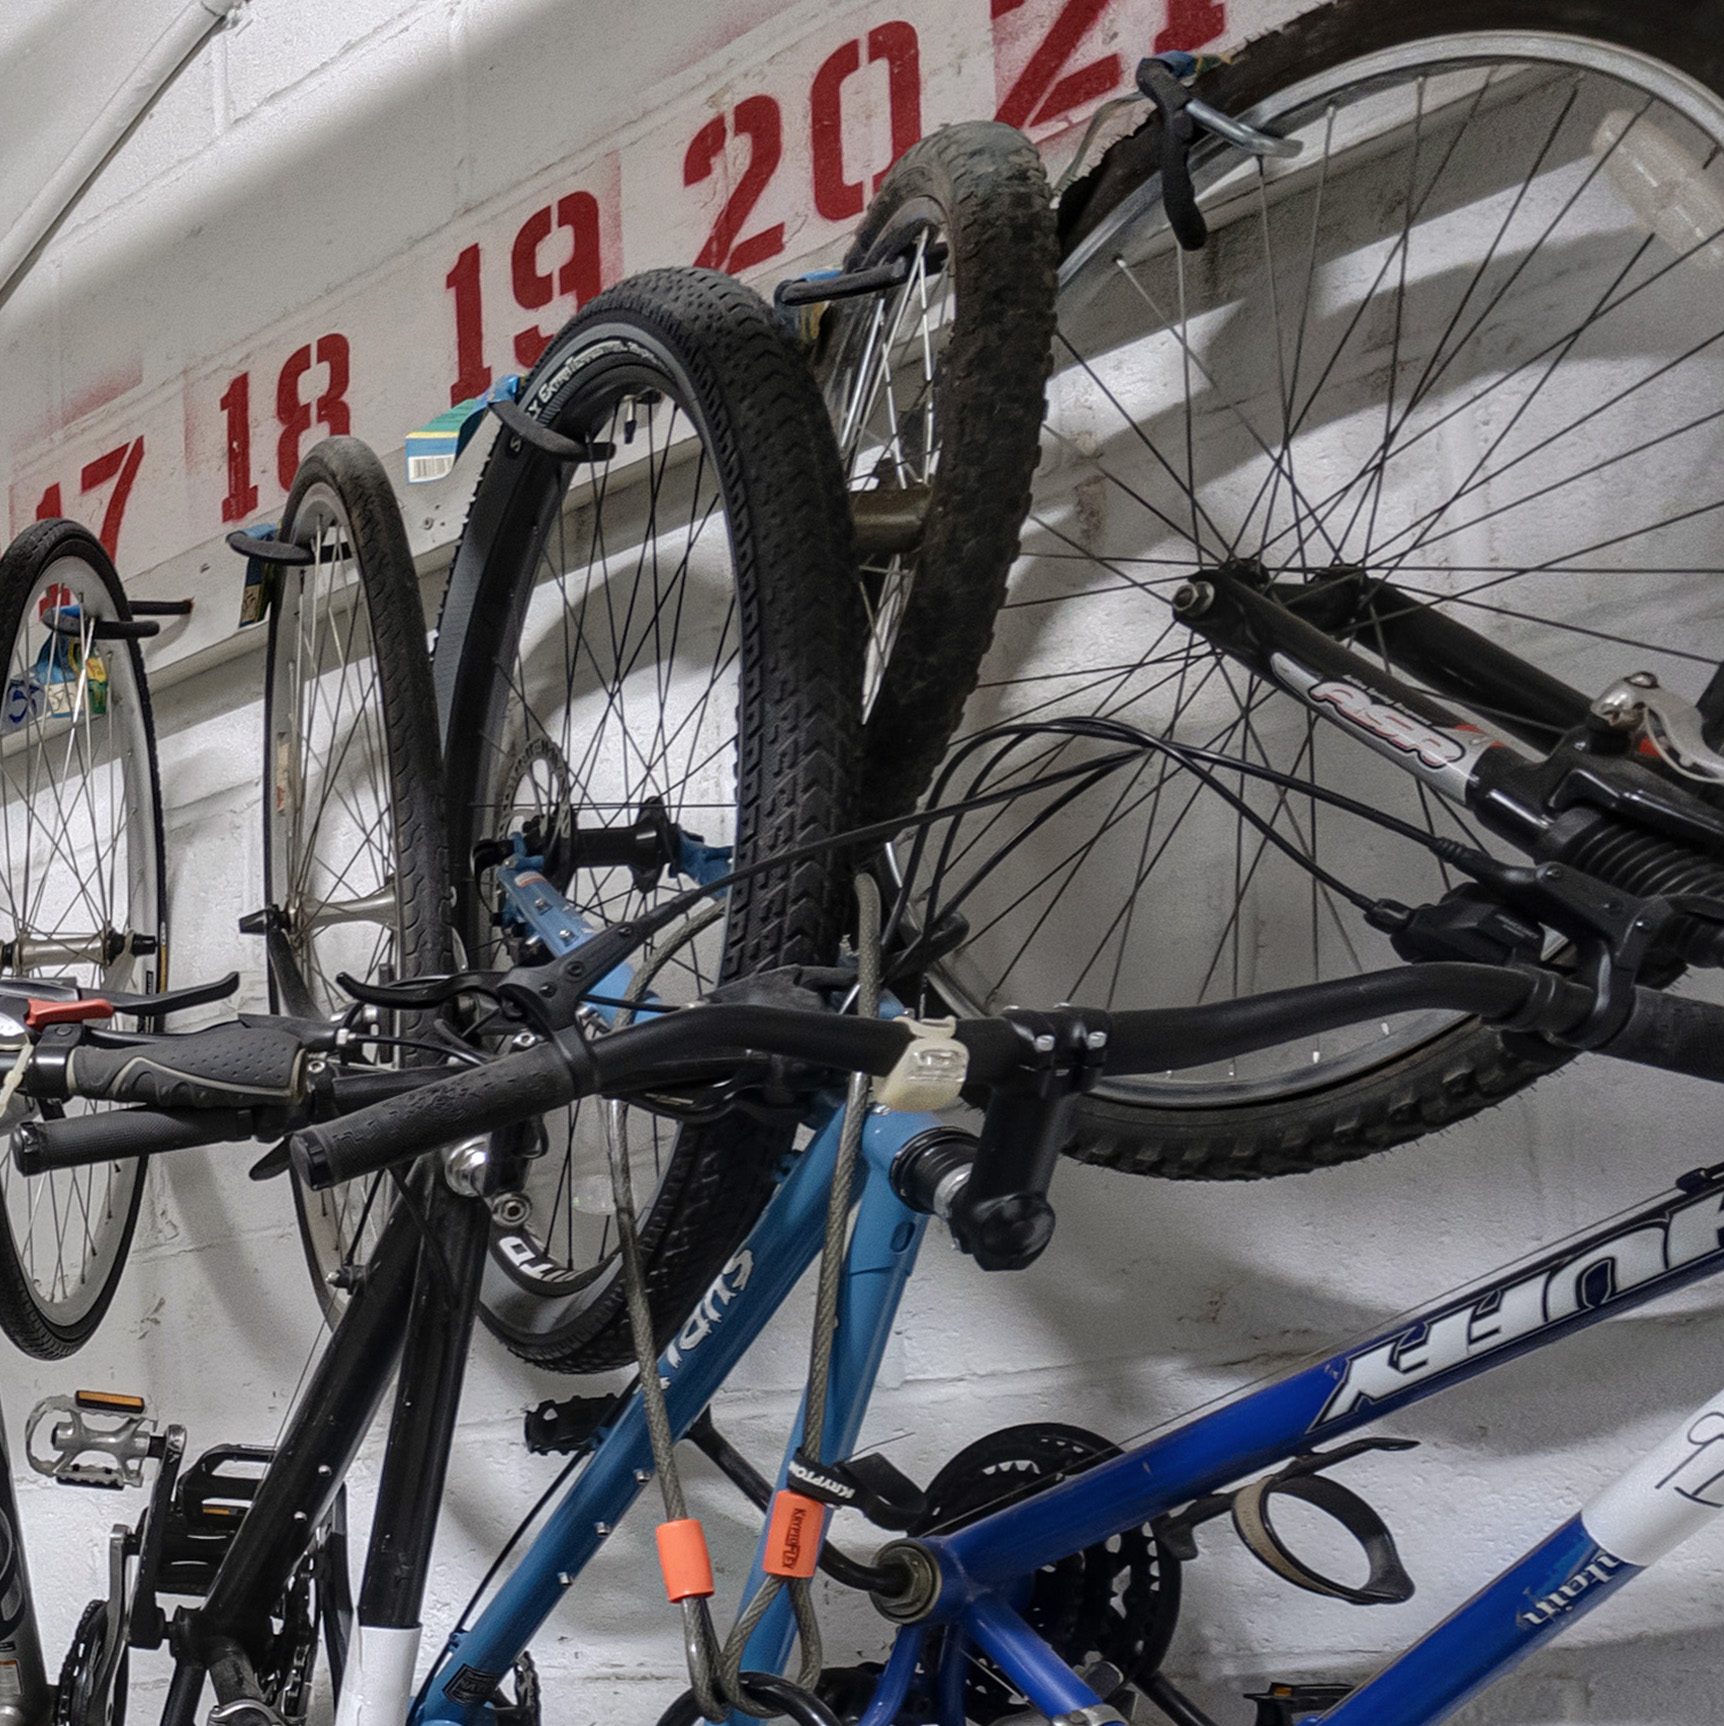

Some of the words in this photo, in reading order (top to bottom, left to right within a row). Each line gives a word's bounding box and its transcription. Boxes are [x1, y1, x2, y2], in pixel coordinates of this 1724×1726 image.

[683, 19, 922, 276] 20
[445, 191, 600, 410] 19
[219, 333, 351, 523] 18
